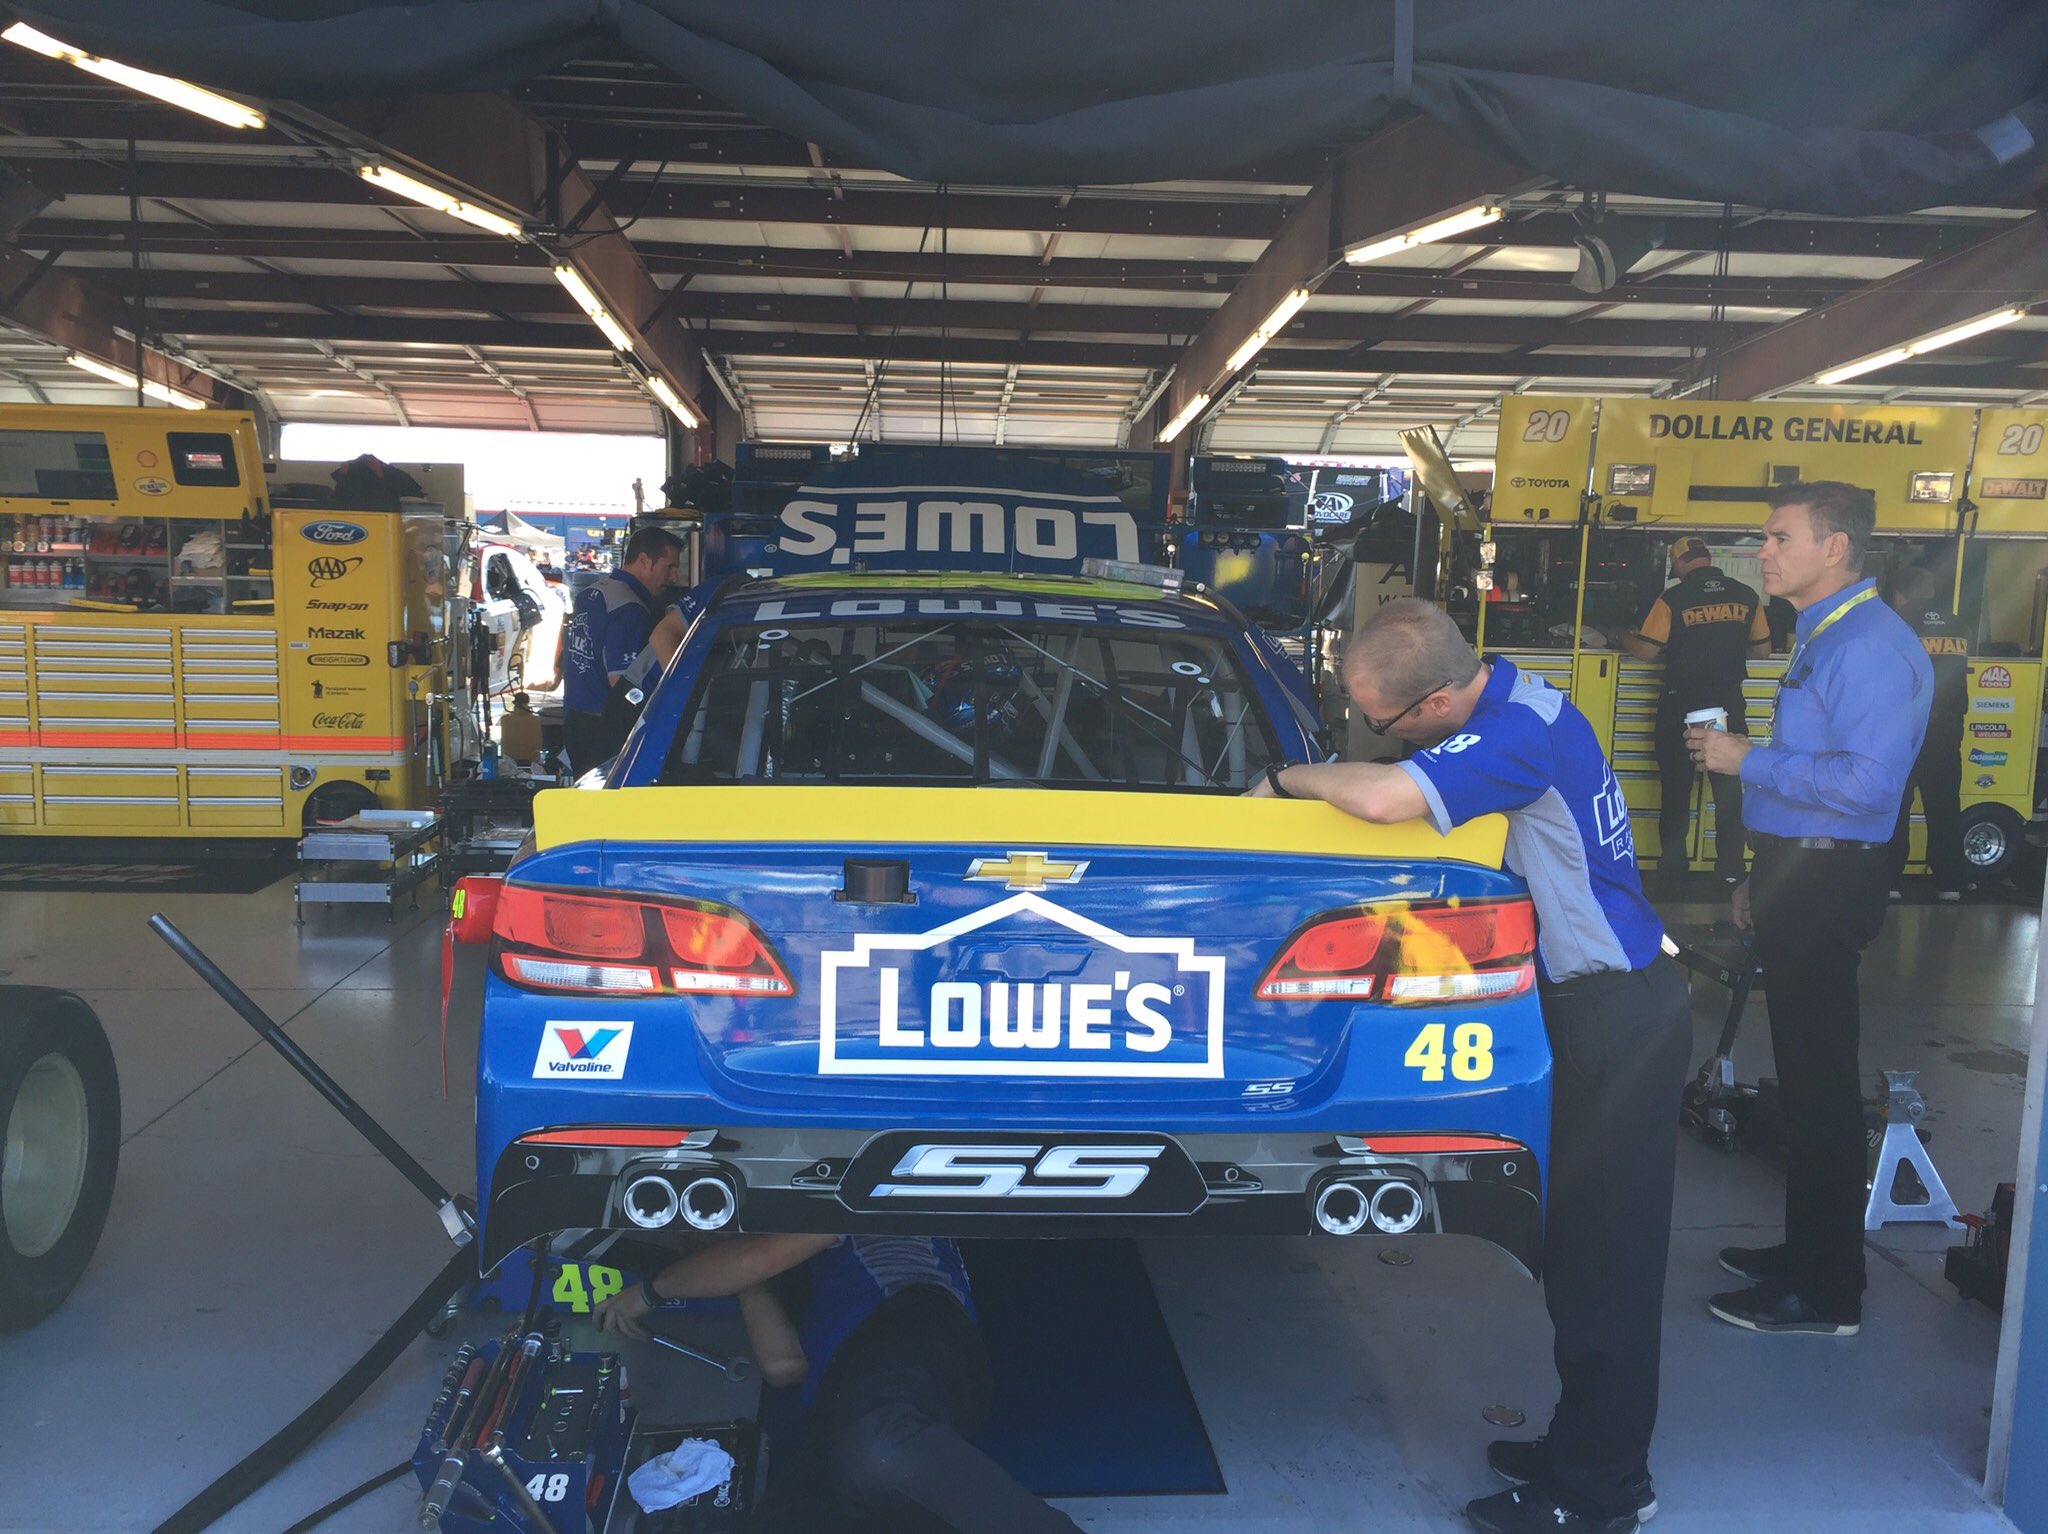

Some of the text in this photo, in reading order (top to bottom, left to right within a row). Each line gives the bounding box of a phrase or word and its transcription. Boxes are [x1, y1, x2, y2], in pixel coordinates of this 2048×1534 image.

[1523, 410, 1570, 443] 20
[1650, 414, 1924, 446] DOLLAR GENERAL
[1998, 423, 2044, 456] 20
[1528, 478, 1570, 489] TOYOTA
[313, 523, 355, 540] Ford
[779, 500, 1140, 565] LOWE'S
[313, 558, 343, 579] AAA
[306, 600, 368, 612] Snap-on
[754, 600, 1187, 630] LOWE'S
[308, 627, 366, 640] Mazak
[1981, 667, 2010, 681] MAC
[452, 889, 466, 919] 48
[879, 967, 1173, 1053] LOWE'S
[548, 1062, 610, 1073] Valvoline
[1404, 1023, 1494, 1082] 48
[1241, 1082, 1296, 1096] SS
[869, 1144, 1166, 1198] SS
[552, 1263, 623, 1313] 48
[525, 1474, 569, 1502] 48
